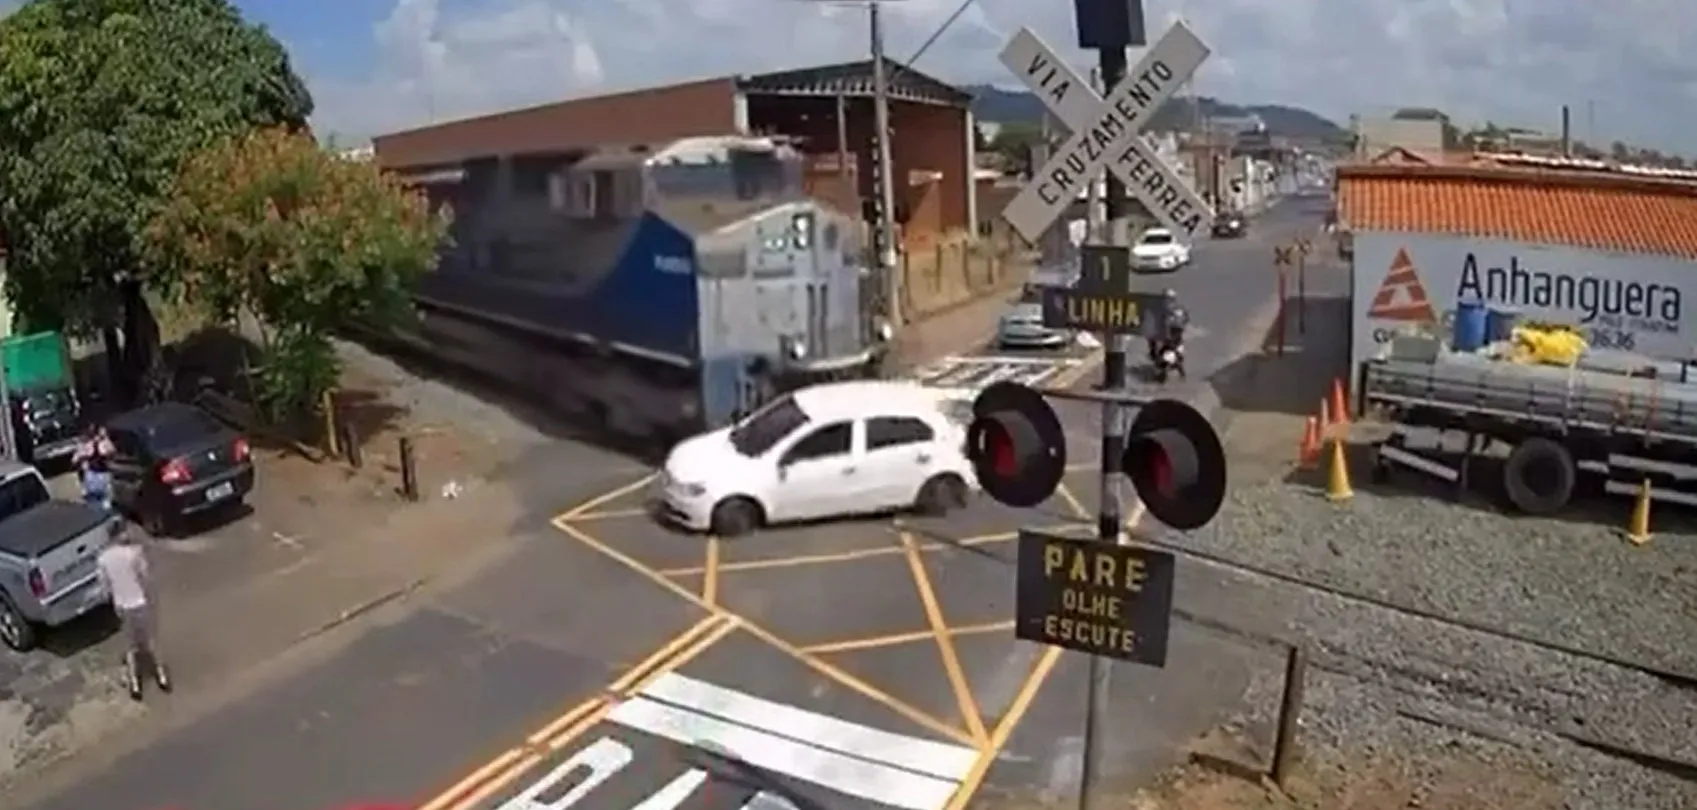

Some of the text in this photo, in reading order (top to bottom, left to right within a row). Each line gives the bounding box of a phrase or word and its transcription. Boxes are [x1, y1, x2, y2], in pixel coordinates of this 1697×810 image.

[1027, 54, 1070, 104] VIA
[1037, 60, 1174, 206] CRUZAMENTO
[1117, 146, 1201, 235] FERREA
[1068, 296, 1141, 326] LINHA
[1457, 253, 1681, 323] Anhanguera
[1044, 543, 1148, 593] PARE
[1062, 588, 1121, 620] OLHE
[1044, 615, 1135, 653] ESCUTE
